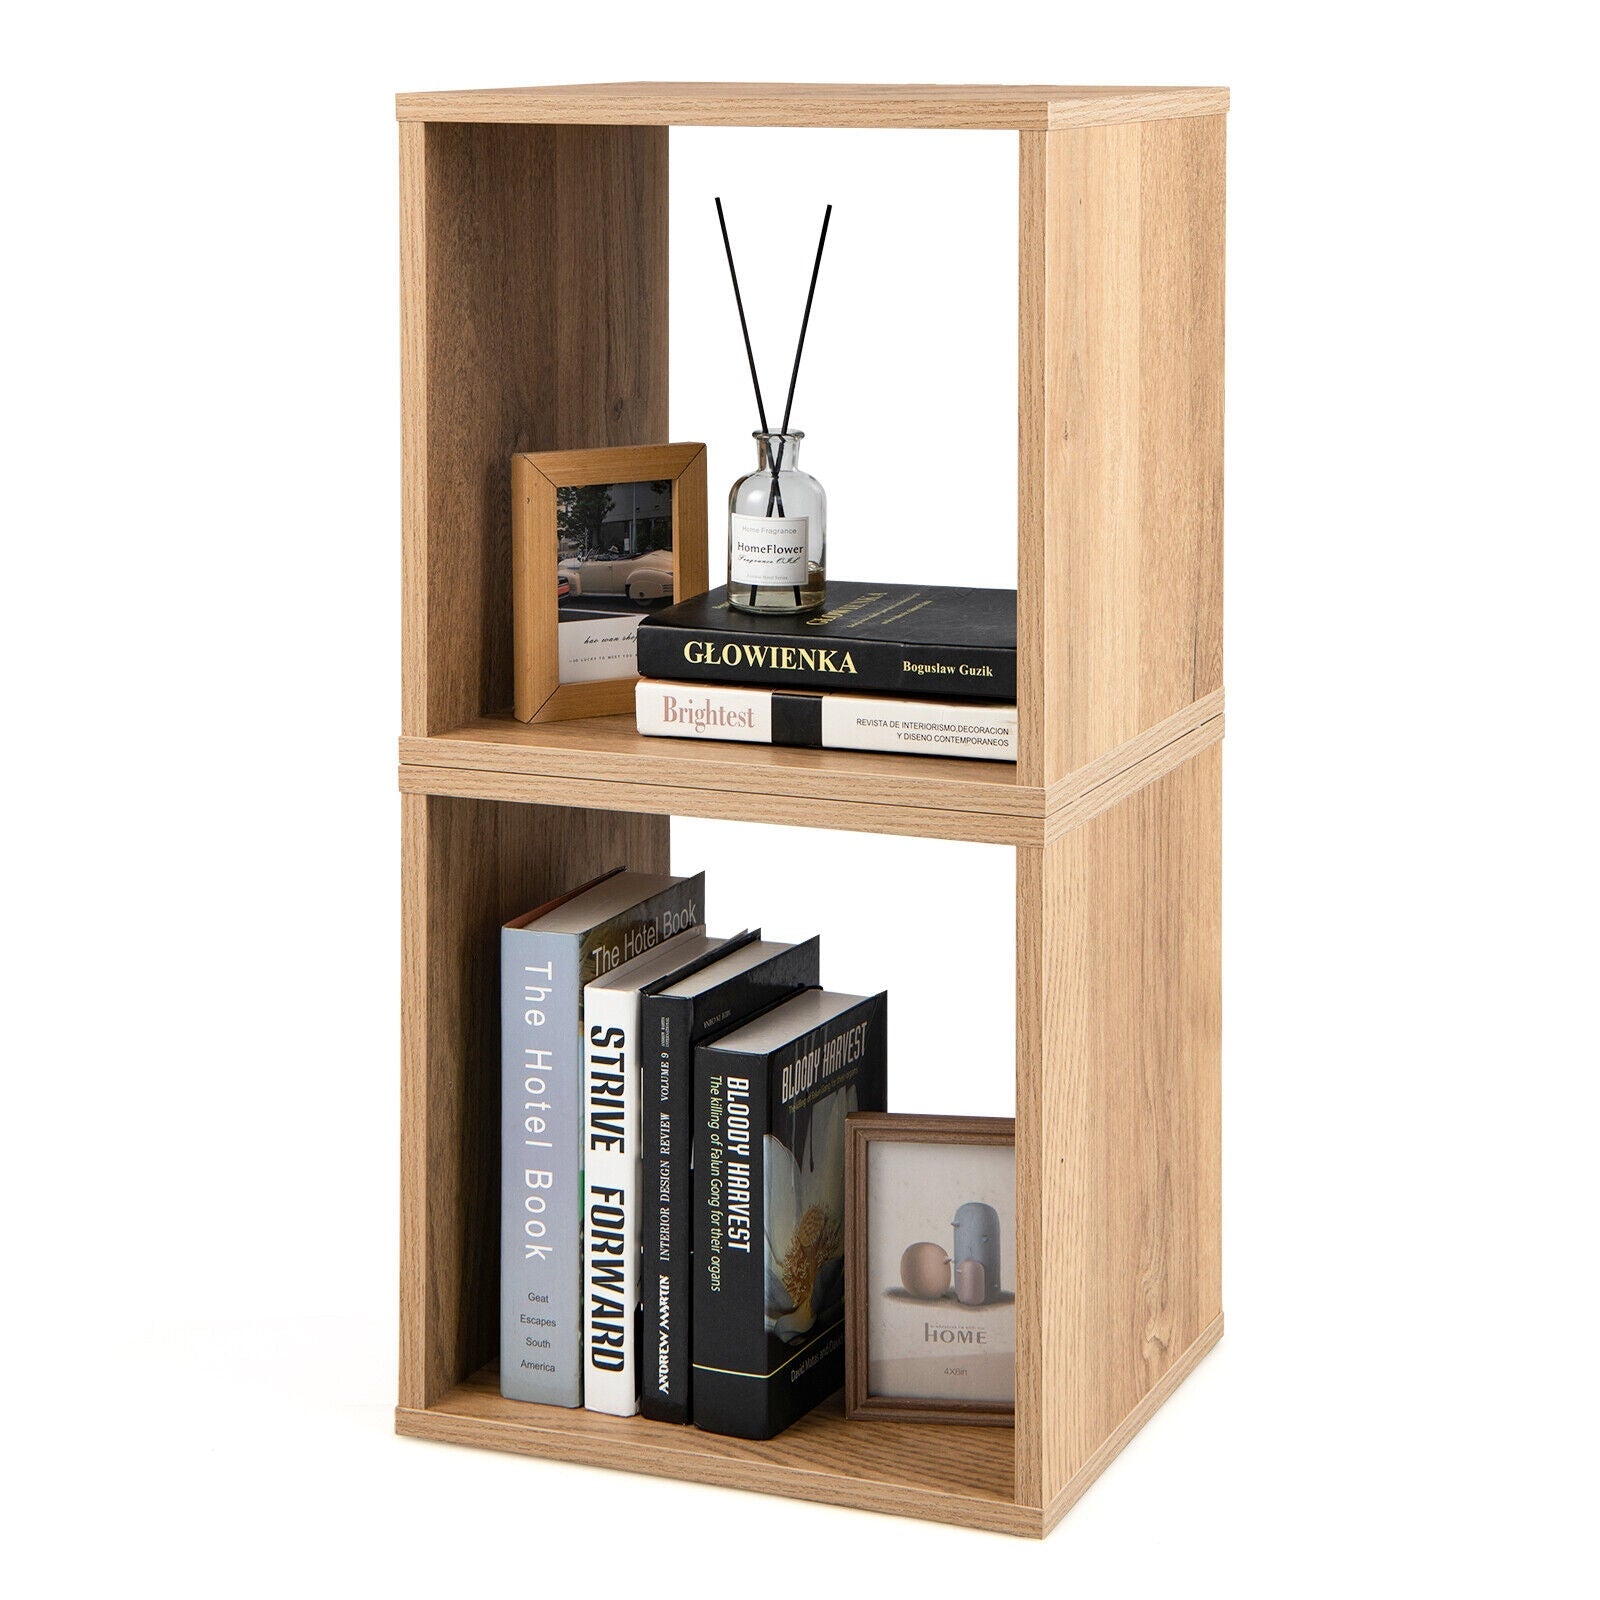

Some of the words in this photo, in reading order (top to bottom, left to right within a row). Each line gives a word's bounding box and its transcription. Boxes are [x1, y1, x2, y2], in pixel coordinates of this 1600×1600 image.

[737, 541, 804, 554] HomeFlower
[761, 527, 798, 535] Fragrance
[683, 640, 858, 675] GŁOWIENKA
[959, 663, 993, 678] Guzik
[662, 695, 755, 734] Brightest
[856, 718, 888, 728] REVISTA
[889, 720, 900, 729] DE
[896, 732, 902, 740] Y
[934, 734, 1009, 748] CONTEMPORANEOS
[592, 946, 620, 977] The
[624, 916, 659, 960] Hotel
[663, 898, 697, 938] Book
[524, 960, 553, 1027] The
[660, 1051, 670, 1060] 9
[782, 1047, 821, 1104] BLOODY
[822, 1021, 868, 1079] HARVEST
[524, 1048, 553, 1148] Hotel
[590, 1025, 625, 1154] STRIVE
[661, 1060, 670, 1102] VOLUME
[709, 1075, 722, 1096] The
[708, 1097, 722, 1130] killing
[726, 1076, 750, 1157] BLOODY
[659, 1112, 670, 1156] REVIEW
[710, 1133, 723, 1146] of
[709, 1147, 723, 1176] Falun
[659, 1160, 670, 1203] DESIGN
[708, 1178, 723, 1208] Gong
[524, 1168, 553, 1261] Book
[709, 1209, 723, 1226] for
[727, 1161, 751, 1254] HARVEST
[659, 1207, 670, 1262] INTERIOR
[710, 1227, 723, 1254] their
[590, 1185, 625, 1373] FORWARD
[707, 1256, 722, 1292] organs
[528, 1291, 549, 1304] Geat
[658, 1274, 670, 1331] MARTIN
[520, 1313, 557, 1328] Escapes
[924, 1322, 988, 1344] HOME
[525, 1336, 551, 1349] South
[520, 1358, 556, 1373] America
[658, 1331, 670, 1395] ANDREW
